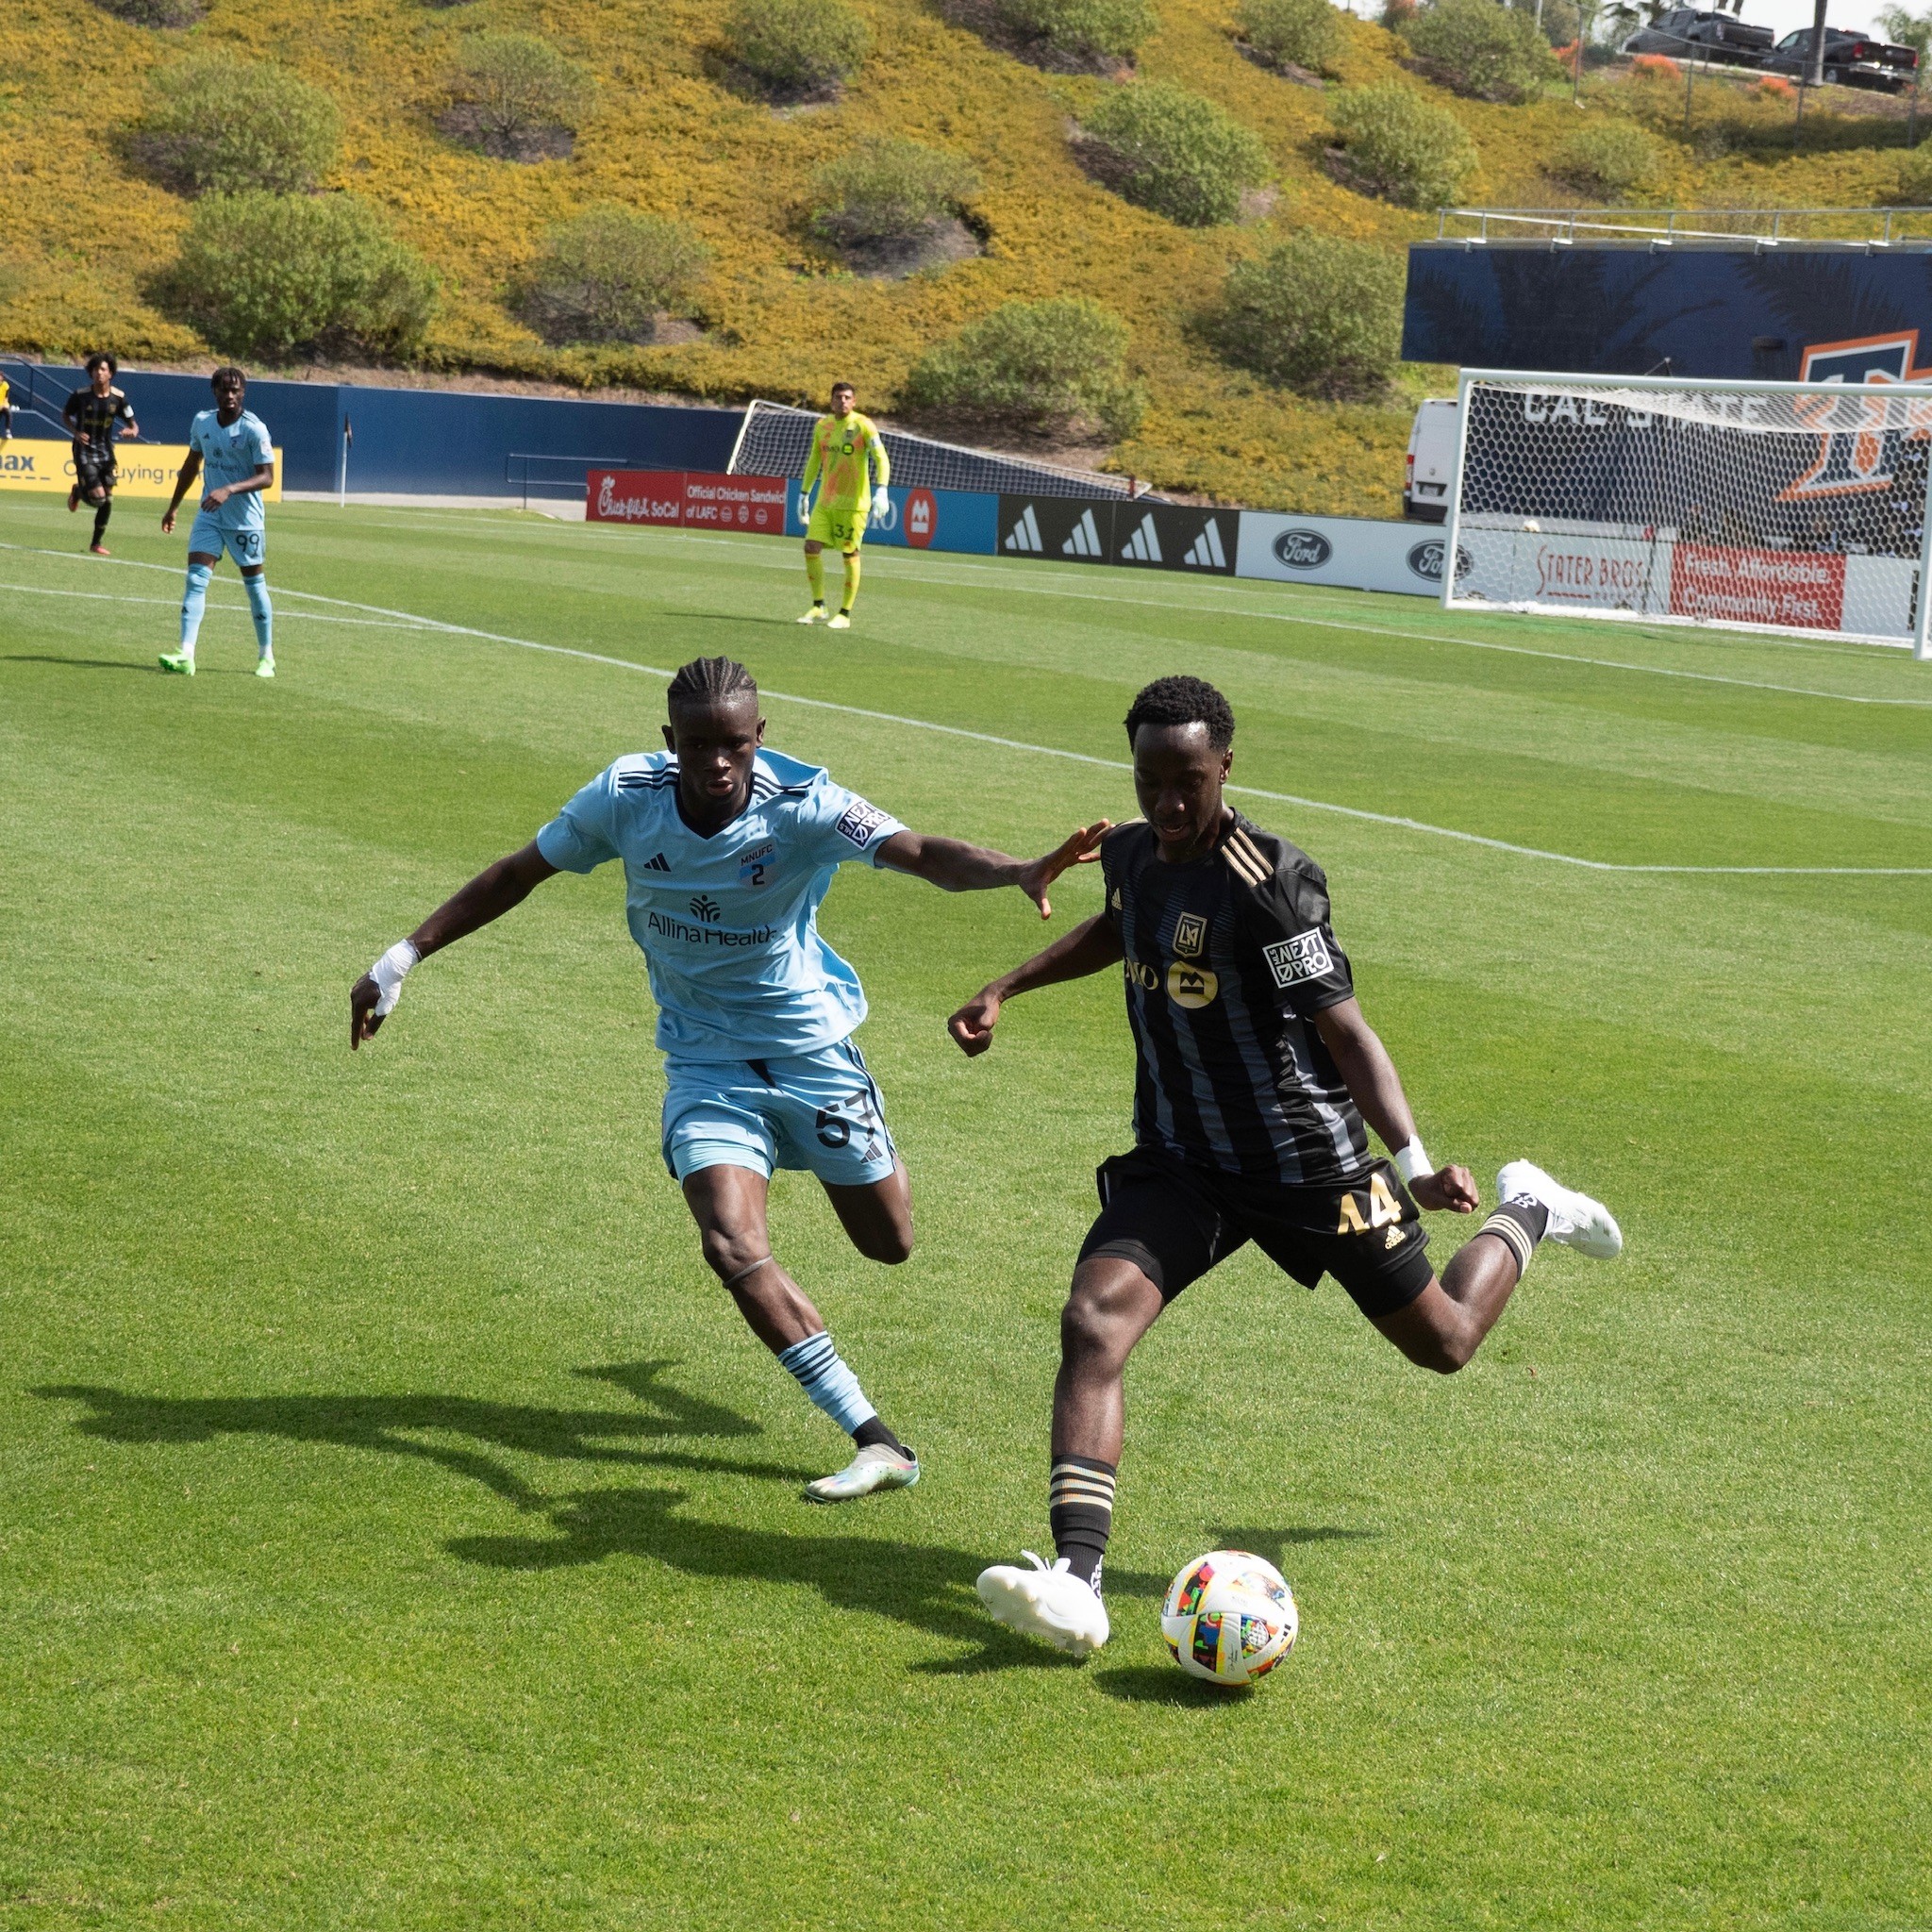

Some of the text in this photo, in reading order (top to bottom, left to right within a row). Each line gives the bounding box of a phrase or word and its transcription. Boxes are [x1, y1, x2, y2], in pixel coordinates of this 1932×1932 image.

[0, 455, 35, 472] ax
[113, 464, 165, 484] uying
[687, 486, 715, 500] Official
[717, 487, 749, 502] Chicken
[651, 501, 679, 519] SoCal
[686, 506, 718, 520] of LAFC
[236, 534, 260, 555] 99
[1283, 534, 1322, 563] Ford
[1419, 546, 1444, 574] Fo
[1535, 544, 1592, 596] STATER
[1683, 586, 1778, 620] Community
[741, 844, 773, 867] MNUFC
[752, 863, 765, 886] 2
[648, 912, 701, 943] Allina
[1279, 934, 1319, 963] NEXT
[1290, 951, 1327, 977] PRO
[815, 1089, 876, 1149] 57
